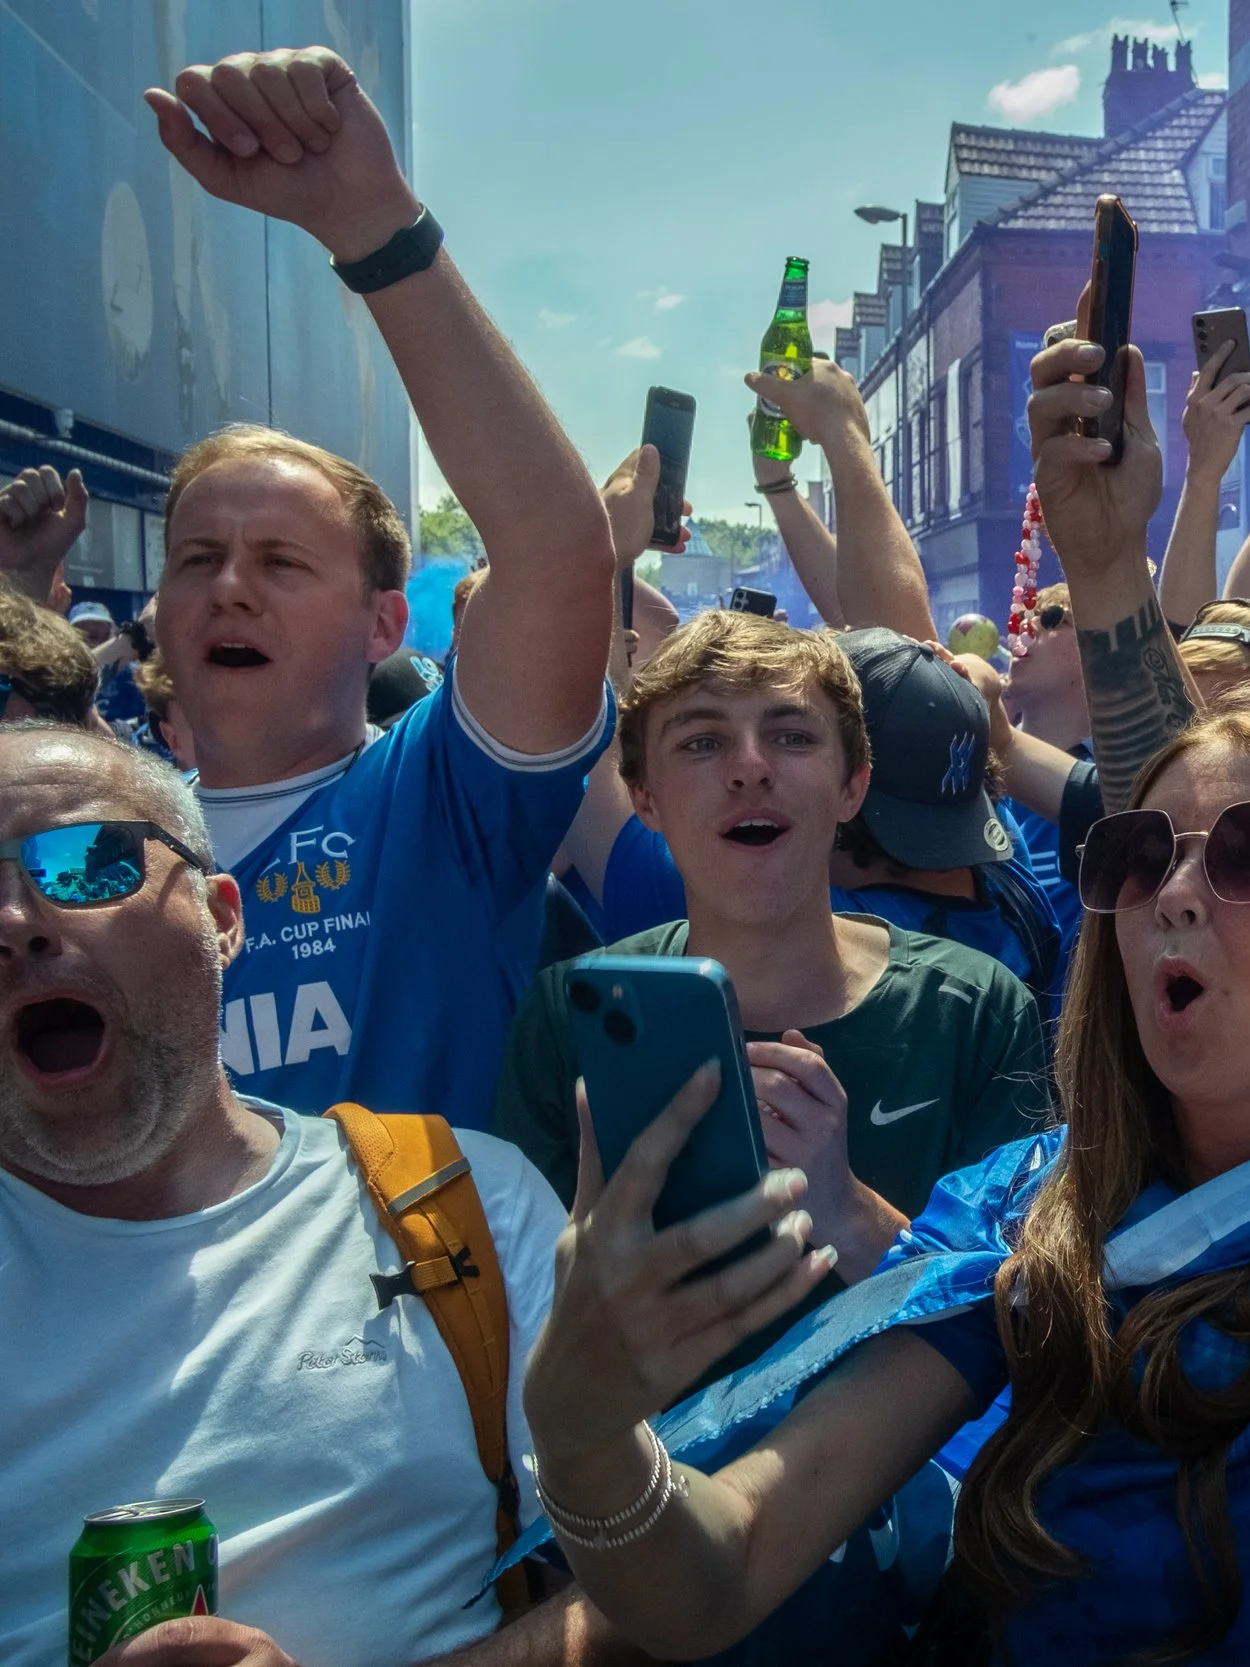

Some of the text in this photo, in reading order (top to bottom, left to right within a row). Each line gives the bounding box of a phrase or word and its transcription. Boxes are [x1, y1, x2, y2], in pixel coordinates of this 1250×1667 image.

[259, 824, 355, 877] FC
[245, 932, 277, 953] F.A.
[281, 921, 319, 943] CUP
[291, 937, 336, 959] 1984
[297, 1345, 388, 1372] Peter Storm
[70, 1539, 195, 1665] EINEKEN
